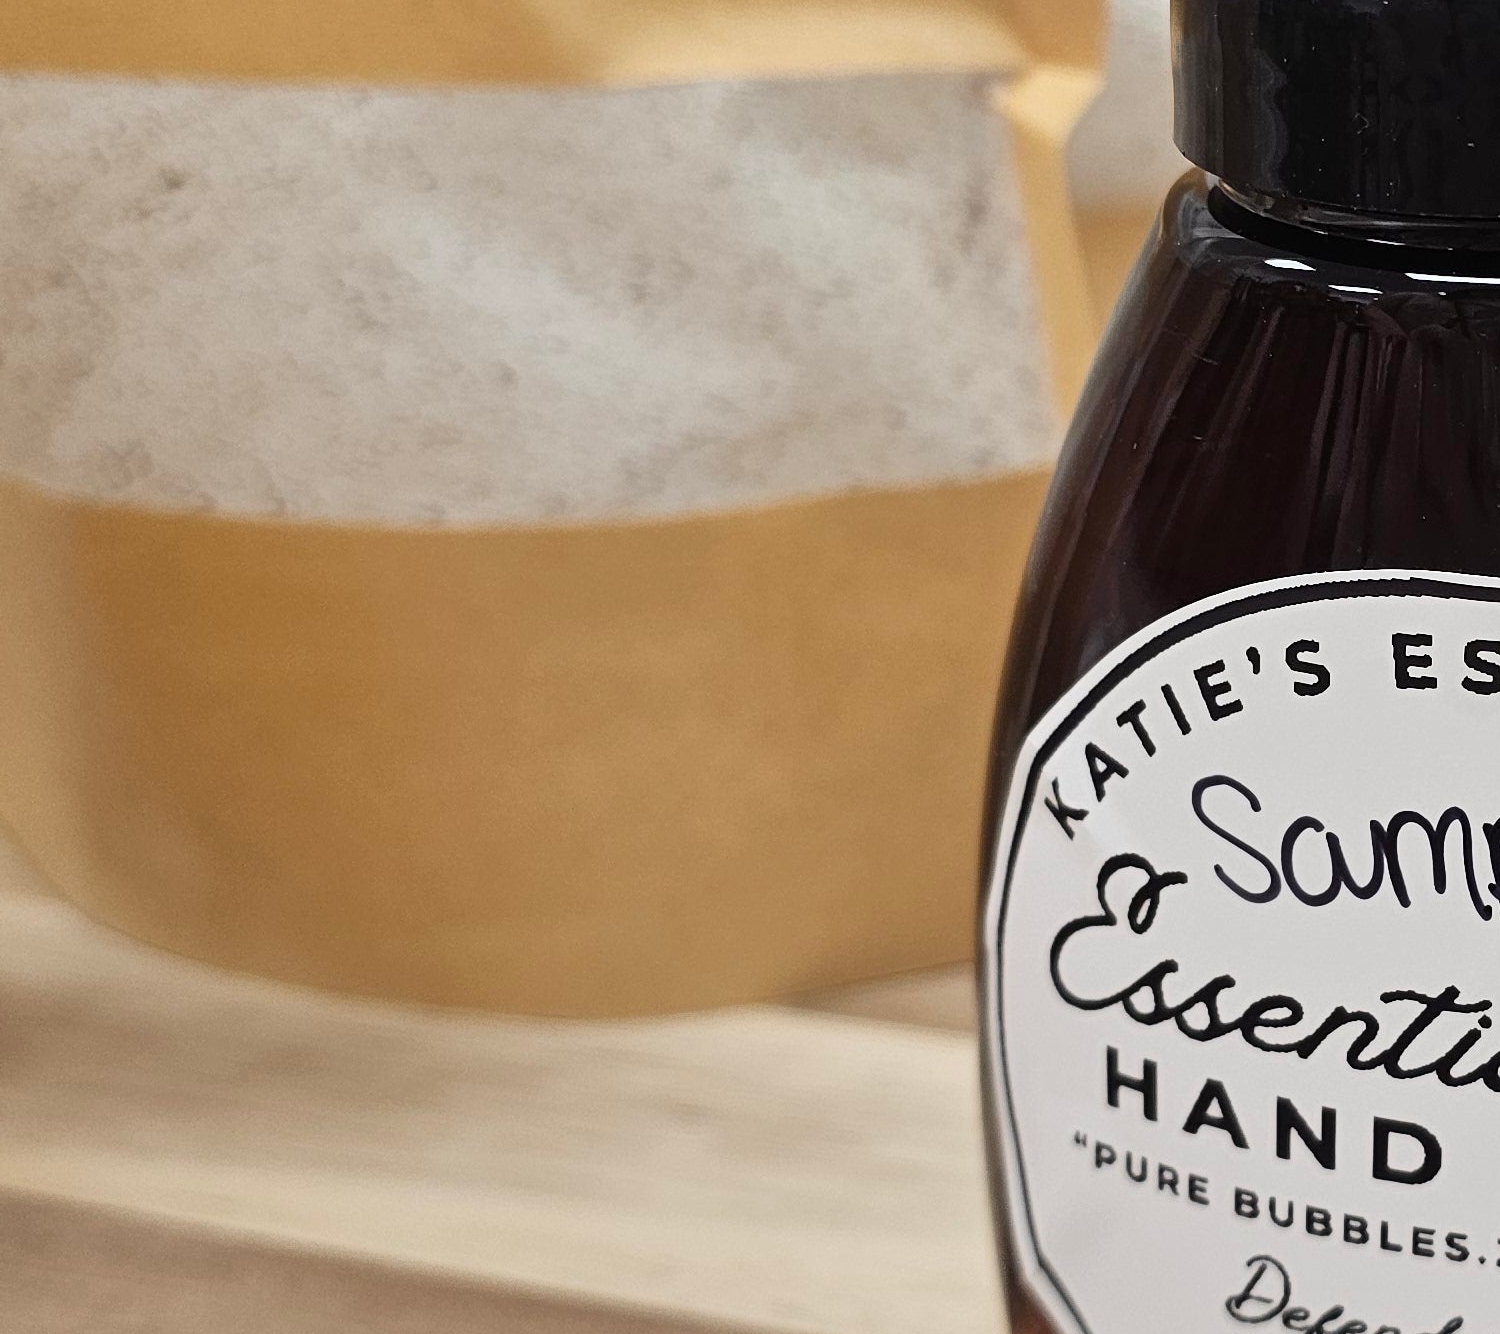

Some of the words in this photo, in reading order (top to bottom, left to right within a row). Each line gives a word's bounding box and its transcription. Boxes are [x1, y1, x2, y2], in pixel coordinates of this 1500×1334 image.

[1044, 639, 1331, 840] KATIE’S
[1073, 1129, 1211, 1206] “PURE
[1106, 1044, 1443, 1185] HAND
